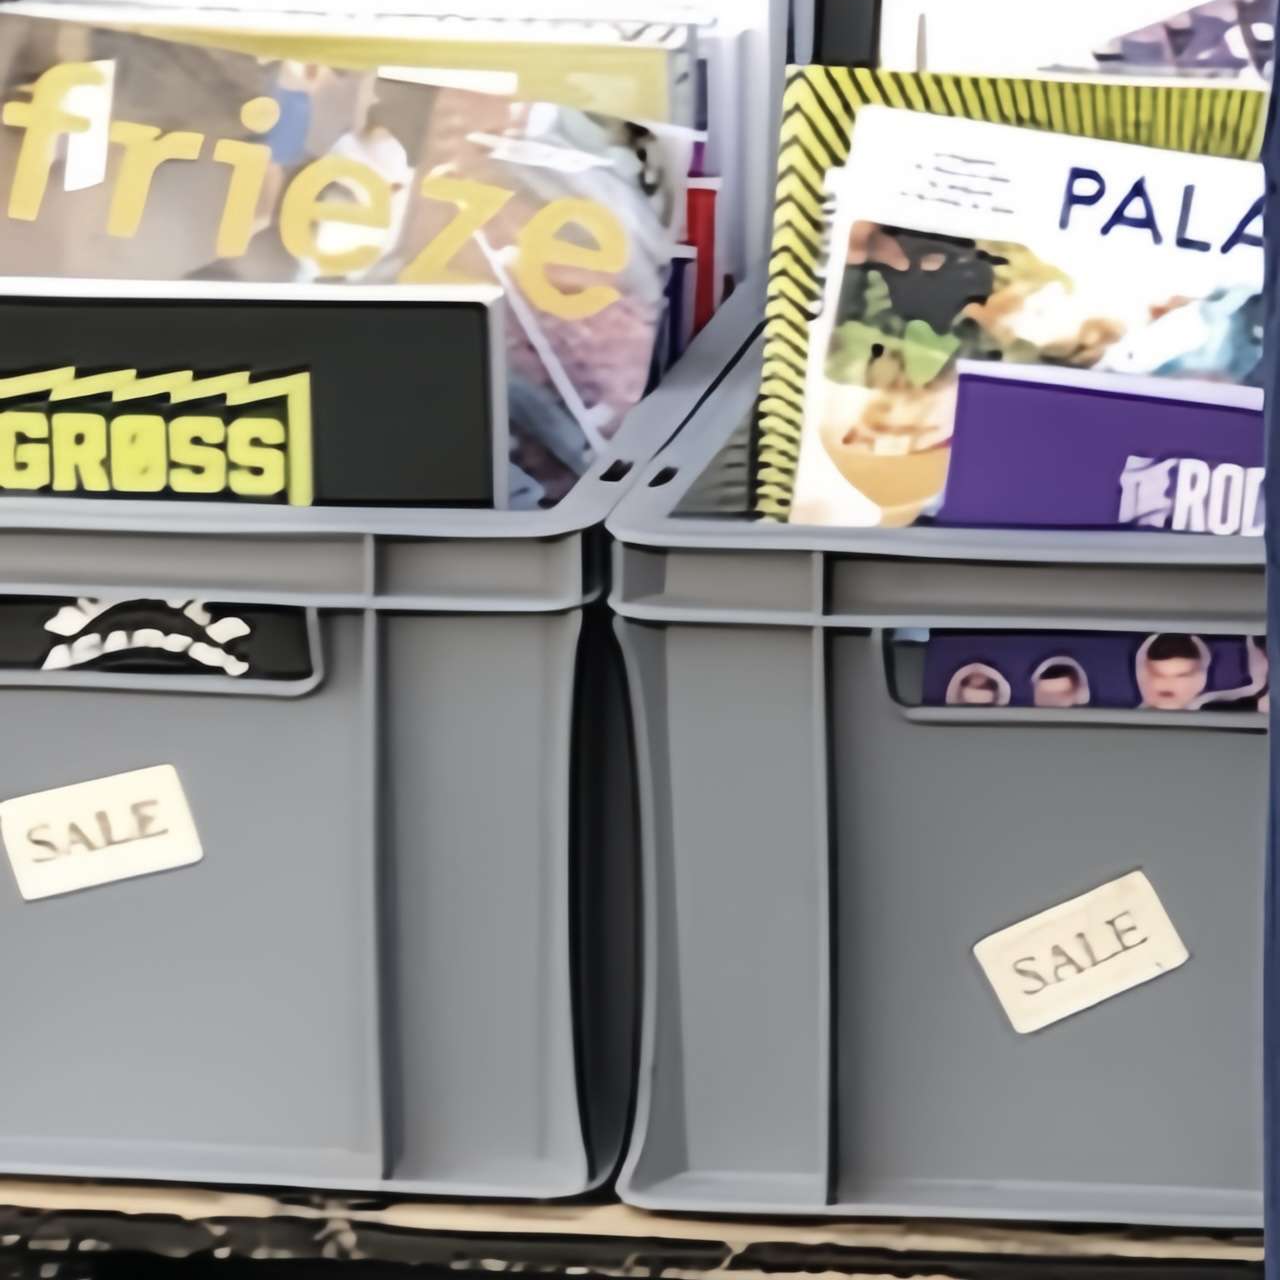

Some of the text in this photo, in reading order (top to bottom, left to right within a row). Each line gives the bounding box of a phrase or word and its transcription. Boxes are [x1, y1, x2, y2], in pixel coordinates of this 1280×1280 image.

[2, 61, 630, 320] frieze
[25, 799, 169, 864] SALE
[1012, 908, 1149, 997] SALE
